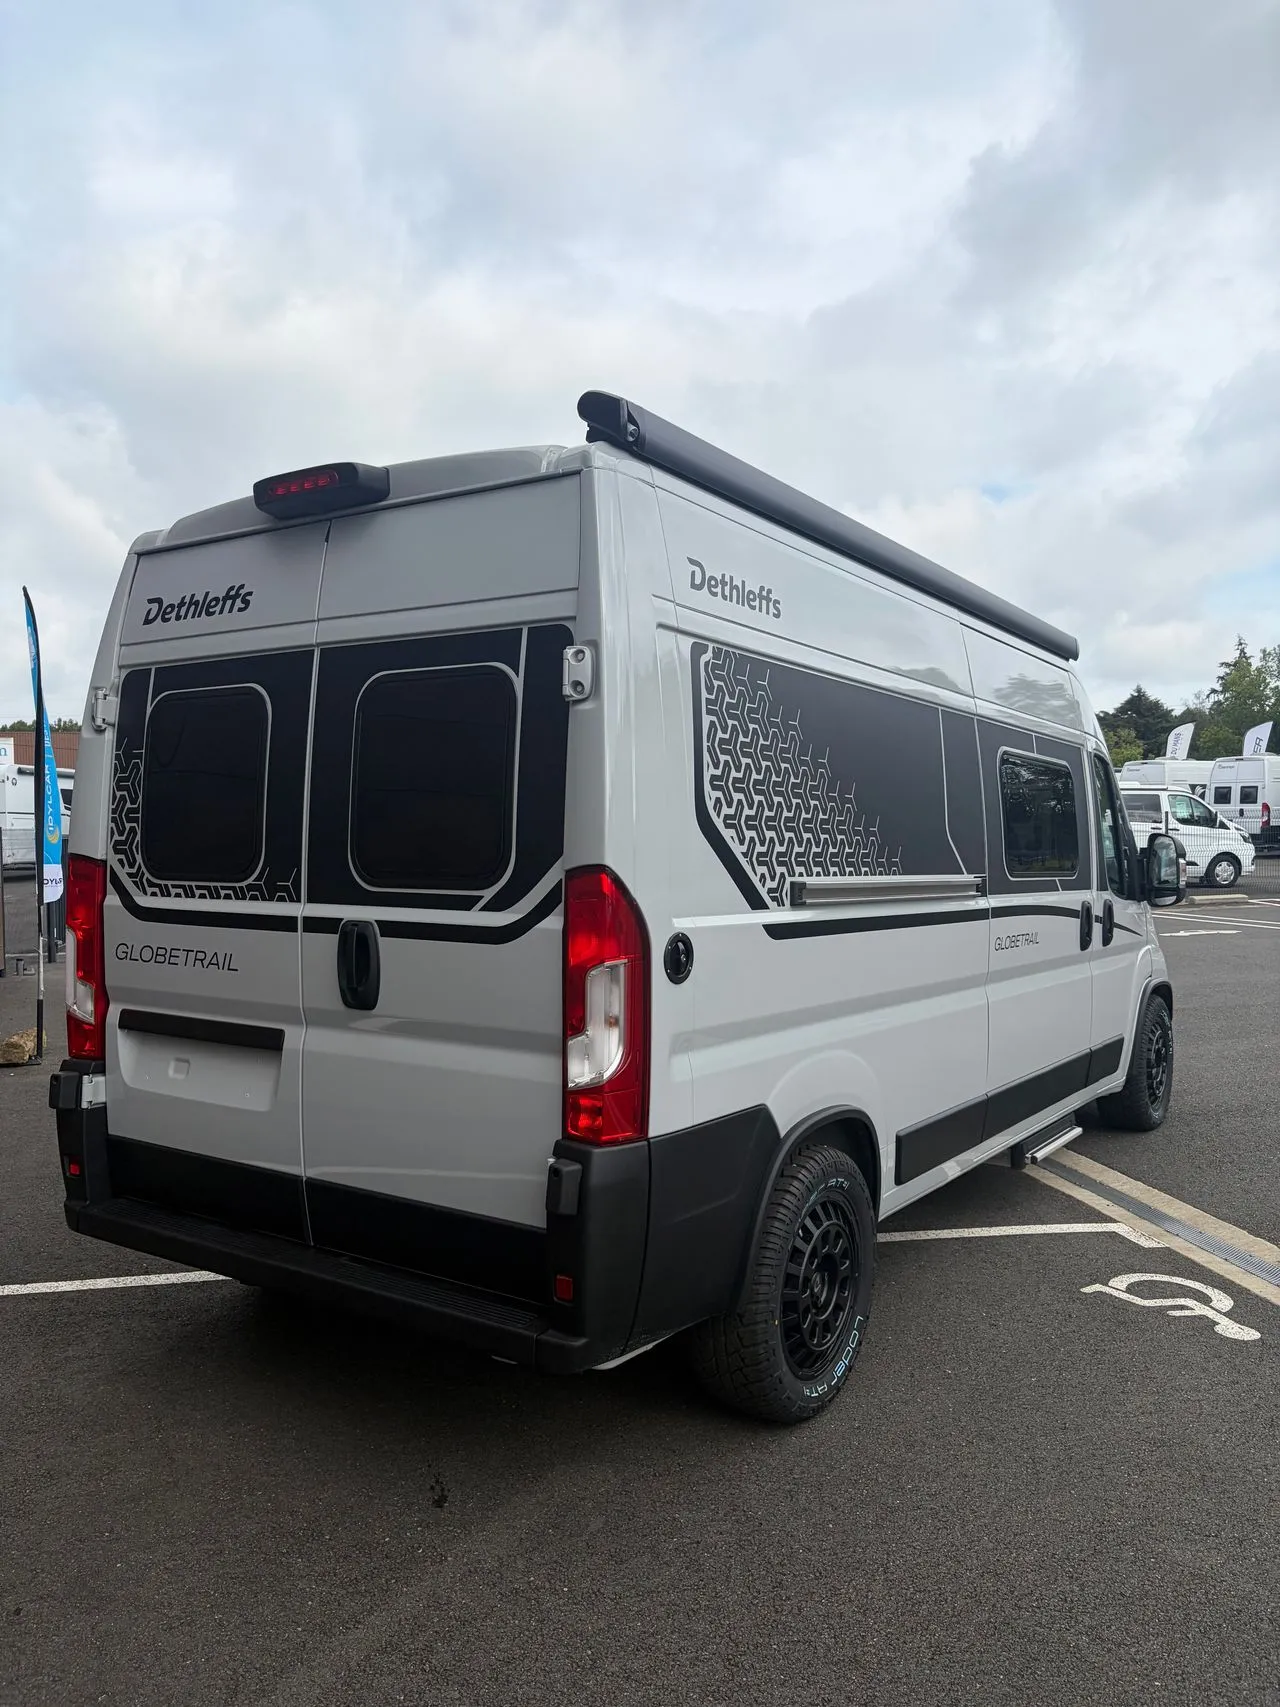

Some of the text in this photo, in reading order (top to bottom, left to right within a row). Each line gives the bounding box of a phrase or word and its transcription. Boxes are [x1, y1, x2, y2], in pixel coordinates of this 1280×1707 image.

[142, 583, 254, 626] Dethleffs
[686, 556, 782, 619] Dethleffs
[115, 942, 239, 972] GLOBETRAIL
[994, 932, 1040, 951] GLOBETRAIL
